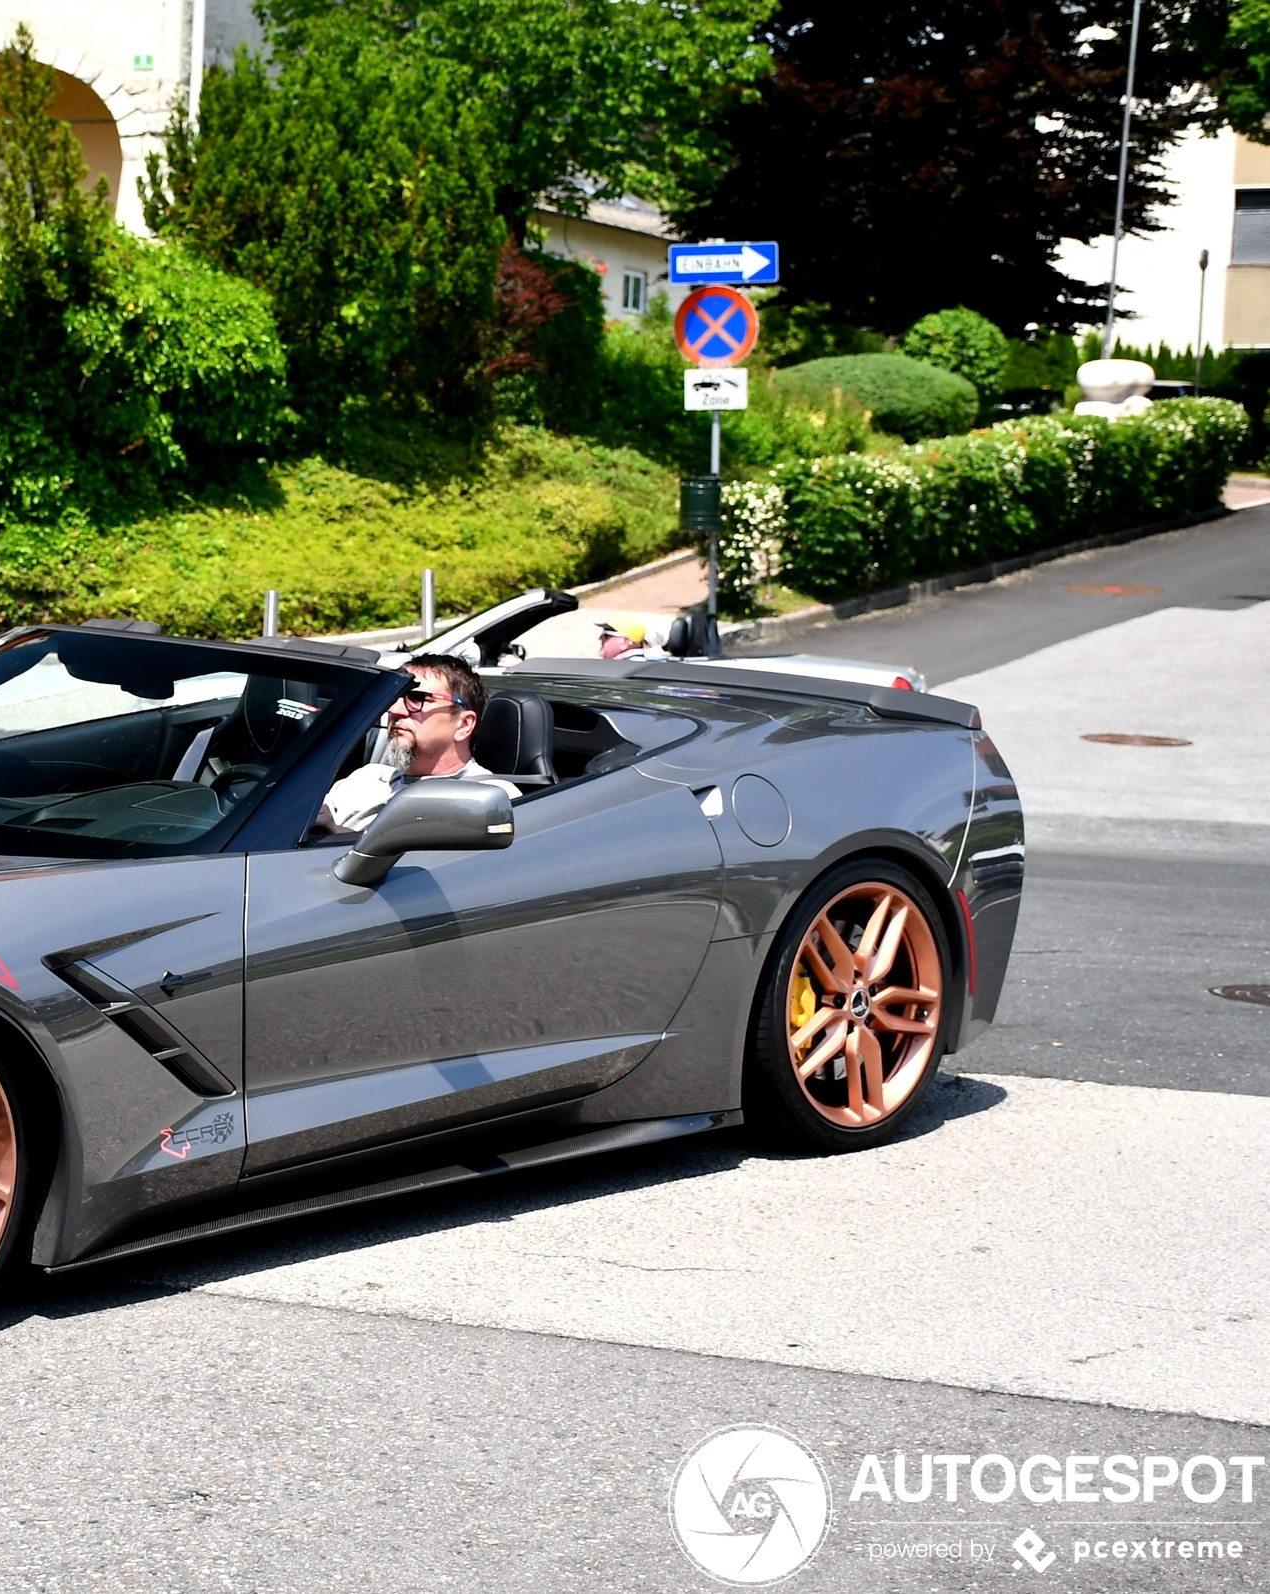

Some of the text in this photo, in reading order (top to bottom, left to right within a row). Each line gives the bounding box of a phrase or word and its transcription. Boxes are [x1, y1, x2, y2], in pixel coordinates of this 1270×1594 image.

[682, 258, 741, 271] EINBAHN
[702, 393, 730, 406] Zone
[171, 1122, 228, 1146] CCRP
